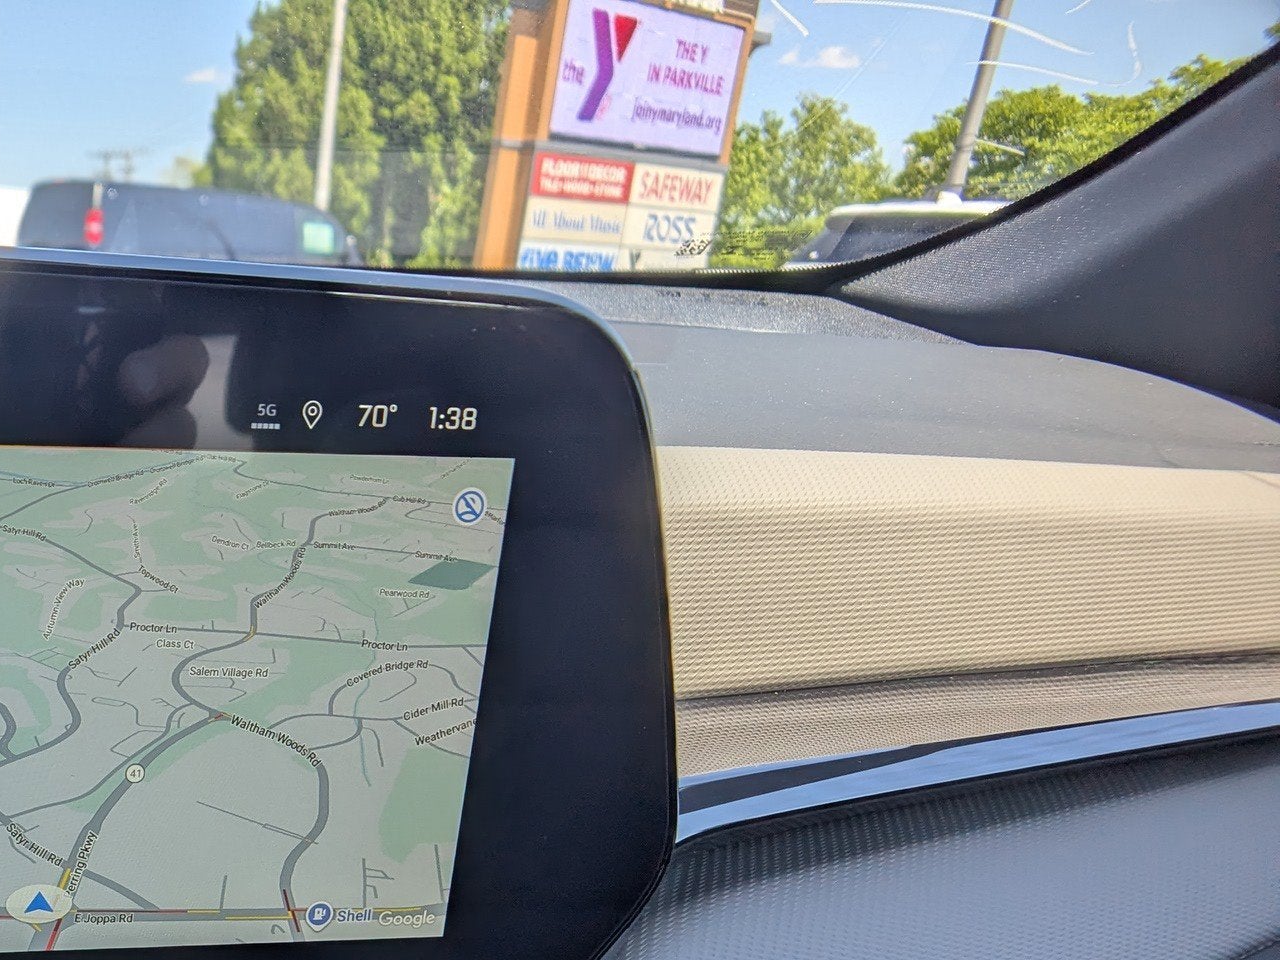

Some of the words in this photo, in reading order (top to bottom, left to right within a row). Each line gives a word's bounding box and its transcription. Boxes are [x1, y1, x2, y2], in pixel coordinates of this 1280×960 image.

[675, 39, 698, 63] THE
[699, 44, 710, 63] Y
[647, 63, 661, 83] IN
[663, 65, 724, 97] PARKVILLE
[631, 96, 722, 135] joinymaryland.org
[640, 172, 713, 203] SAFEWAY
[644, 213, 696, 243] ROSS
[257, 404, 276, 417] 5G
[358, 404, 398, 427] 70°
[430, 406, 478, 430] 1:38
[2, 524, 22, 538] Satyr
[22, 528, 35, 538] Hill
[35, 531, 47, 542] Rd
[313, 541, 340, 549] Summit
[415, 551, 441, 561] Summit
[138, 565, 170, 592] Topwood
[168, 585, 179, 594] Ct
[255, 581, 287, 609] Waltham
[284, 560, 302, 587] Woods
[297, 547, 306, 560] Rd
[379, 588, 416, 598] Pearwood
[43, 603, 60, 640] Autumn
[54, 586, 68, 606] View
[66, 579, 85, 594] Way
[130, 622, 163, 633] Proctor
[165, 625, 178, 633] Ln
[68, 648, 92, 670] Satyr
[90, 637, 108, 655] Hill
[107, 628, 120, 643] Rd
[156, 639, 182, 648] Class
[183, 640, 195, 650] Ct
[361, 639, 393, 650] Proctor
[395, 642, 408, 651] Ln
[189, 667, 219, 677] Salem
[221, 667, 253, 679] Village
[255, 668, 269, 678] Rd
[346, 666, 383, 688] Covered
[385, 660, 415, 674] Bridge
[416, 660, 429, 669] Rd
[403, 708, 429, 721] Cider
[431, 702, 450, 714] Mill
[450, 698, 464, 708] Rd
[230, 714, 276, 740] Waltham
[277, 732, 309, 757] Woods
[306, 751, 321, 768] Rd
[130, 770, 141, 778] 41
[6, 823, 30, 846] Satyr
[29, 841, 48, 859] Hill
[46, 852, 63, 868] Rd
[78, 831, 98, 860] Pkwy
[74, 914, 81, 923] E
[83, 914, 117, 926] Joppa
[118, 913, 134, 923] Rd
[337, 909, 373, 923] Shell
[378, 911, 436, 928] Google
